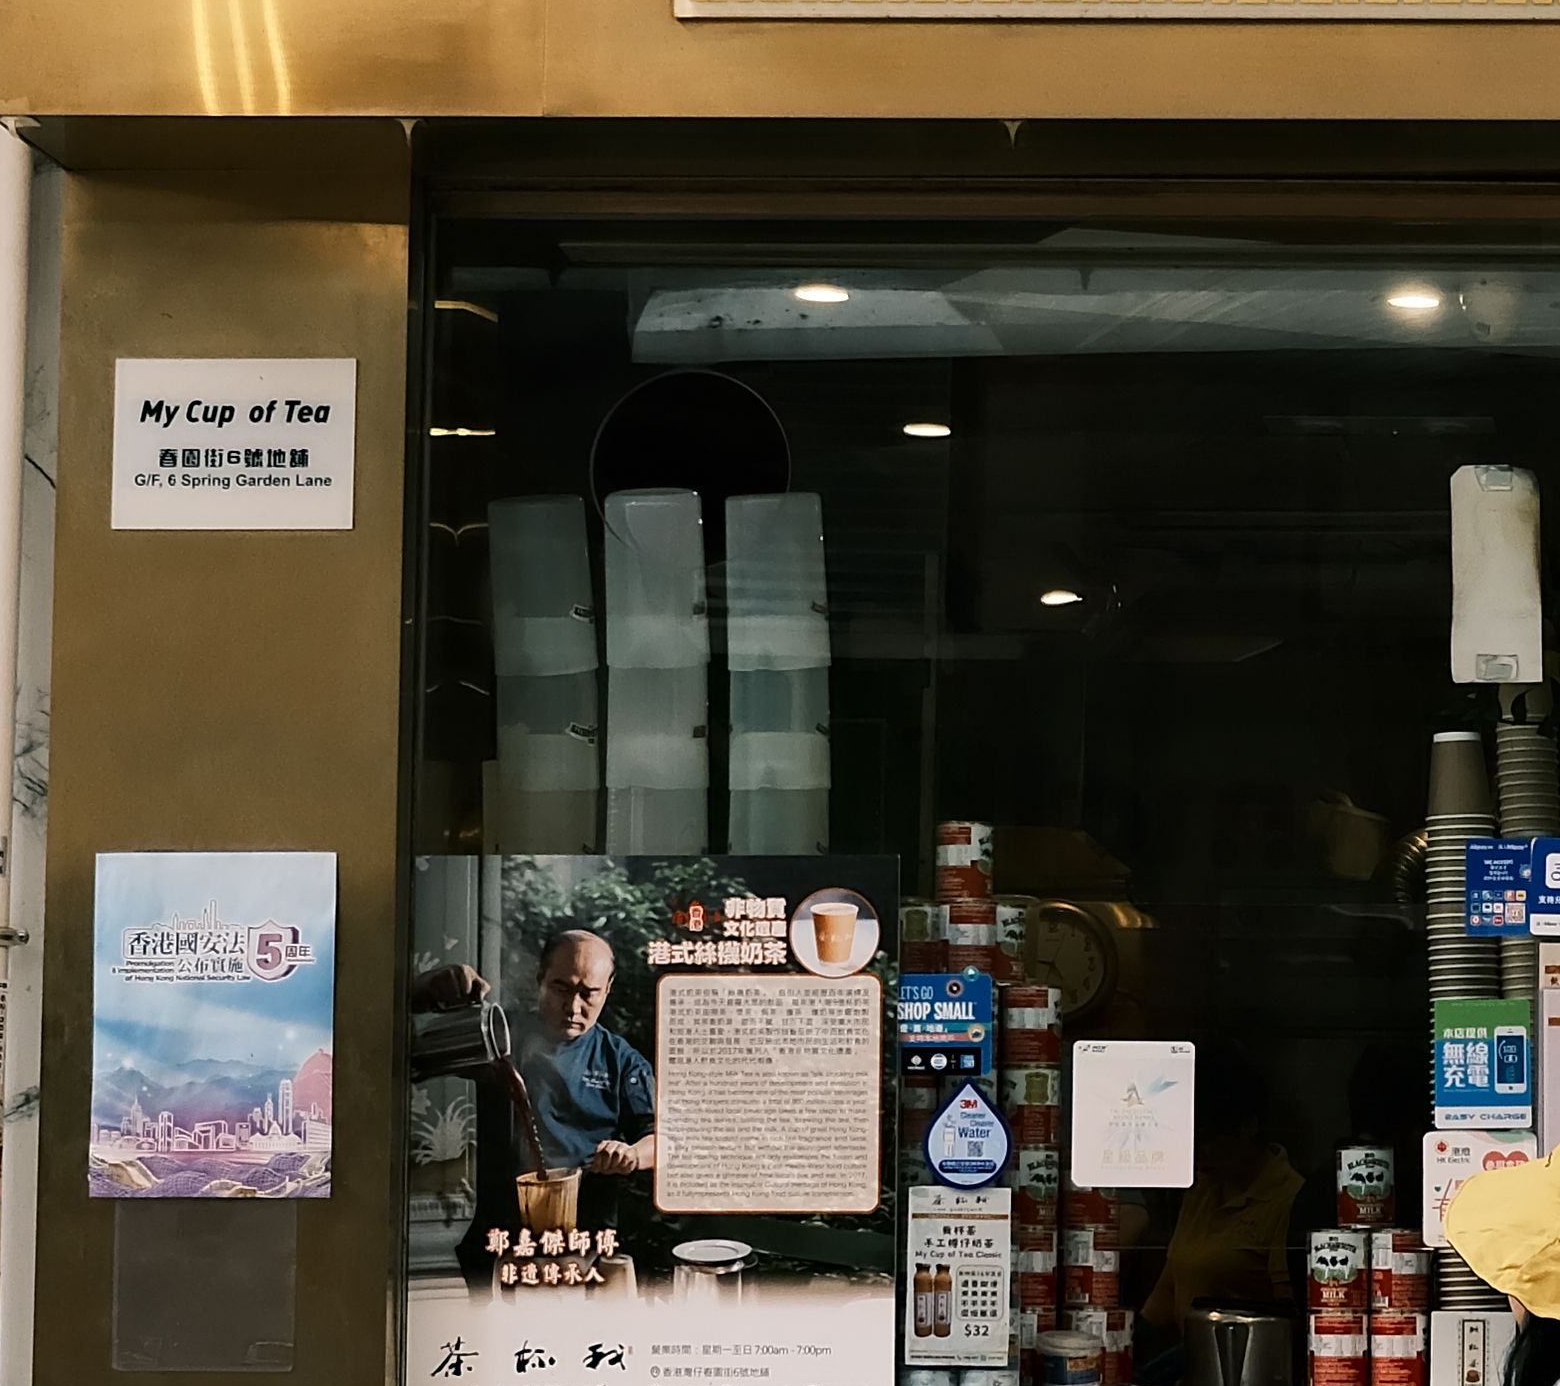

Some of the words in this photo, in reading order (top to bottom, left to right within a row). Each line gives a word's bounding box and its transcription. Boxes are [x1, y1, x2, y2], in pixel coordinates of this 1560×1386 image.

[140, 399, 180, 428] My
[185, 399, 236, 428] Cup
[248, 399, 277, 424] of
[284, 399, 331, 424] Tea
[134, 474, 164, 488] G/F,
[167, 474, 177, 486] 6
[181, 474, 231, 489] Spring
[236, 474, 290, 487] Garden
[295, 474, 332, 487] Lane
[724, 897, 787, 919] 非物質
[128, 931, 246, 956] 香港國安法
[285, 945, 311, 957] 周年
[256, 933, 283, 970] 5
[647, 940, 787, 965] 港式絲襪奶茶
[177, 958, 244, 974] 公布實施
[134, 975, 154, 983] Hong
[156, 975, 174, 983] Kong
[920, 986, 934, 1000] GO
[897, 1001, 932, 1021] SHOP
[933, 1001, 976, 1021] SMALL
[1442, 1041, 1489, 1066] 無線
[1443, 1066, 1490, 1088] 充電
[959, 1099, 978, 1110] 3M
[1480, 1113, 1527, 1121] CHARGE
[957, 1127, 991, 1139] Water
[1358, 1206, 1382, 1215] MILK
[484, 1227, 621, 1258] 鄭嘉傑師傅
[915, 1250, 927, 1259] My
[500, 1263, 606, 1286] 非遺傳承人
[1321, 1290, 1346, 1299] MILK
[964, 1323, 989, 1337] $32
[755, 1344, 789, 1356] 7:00am
[796, 1344, 833, 1358] 7:00pm
